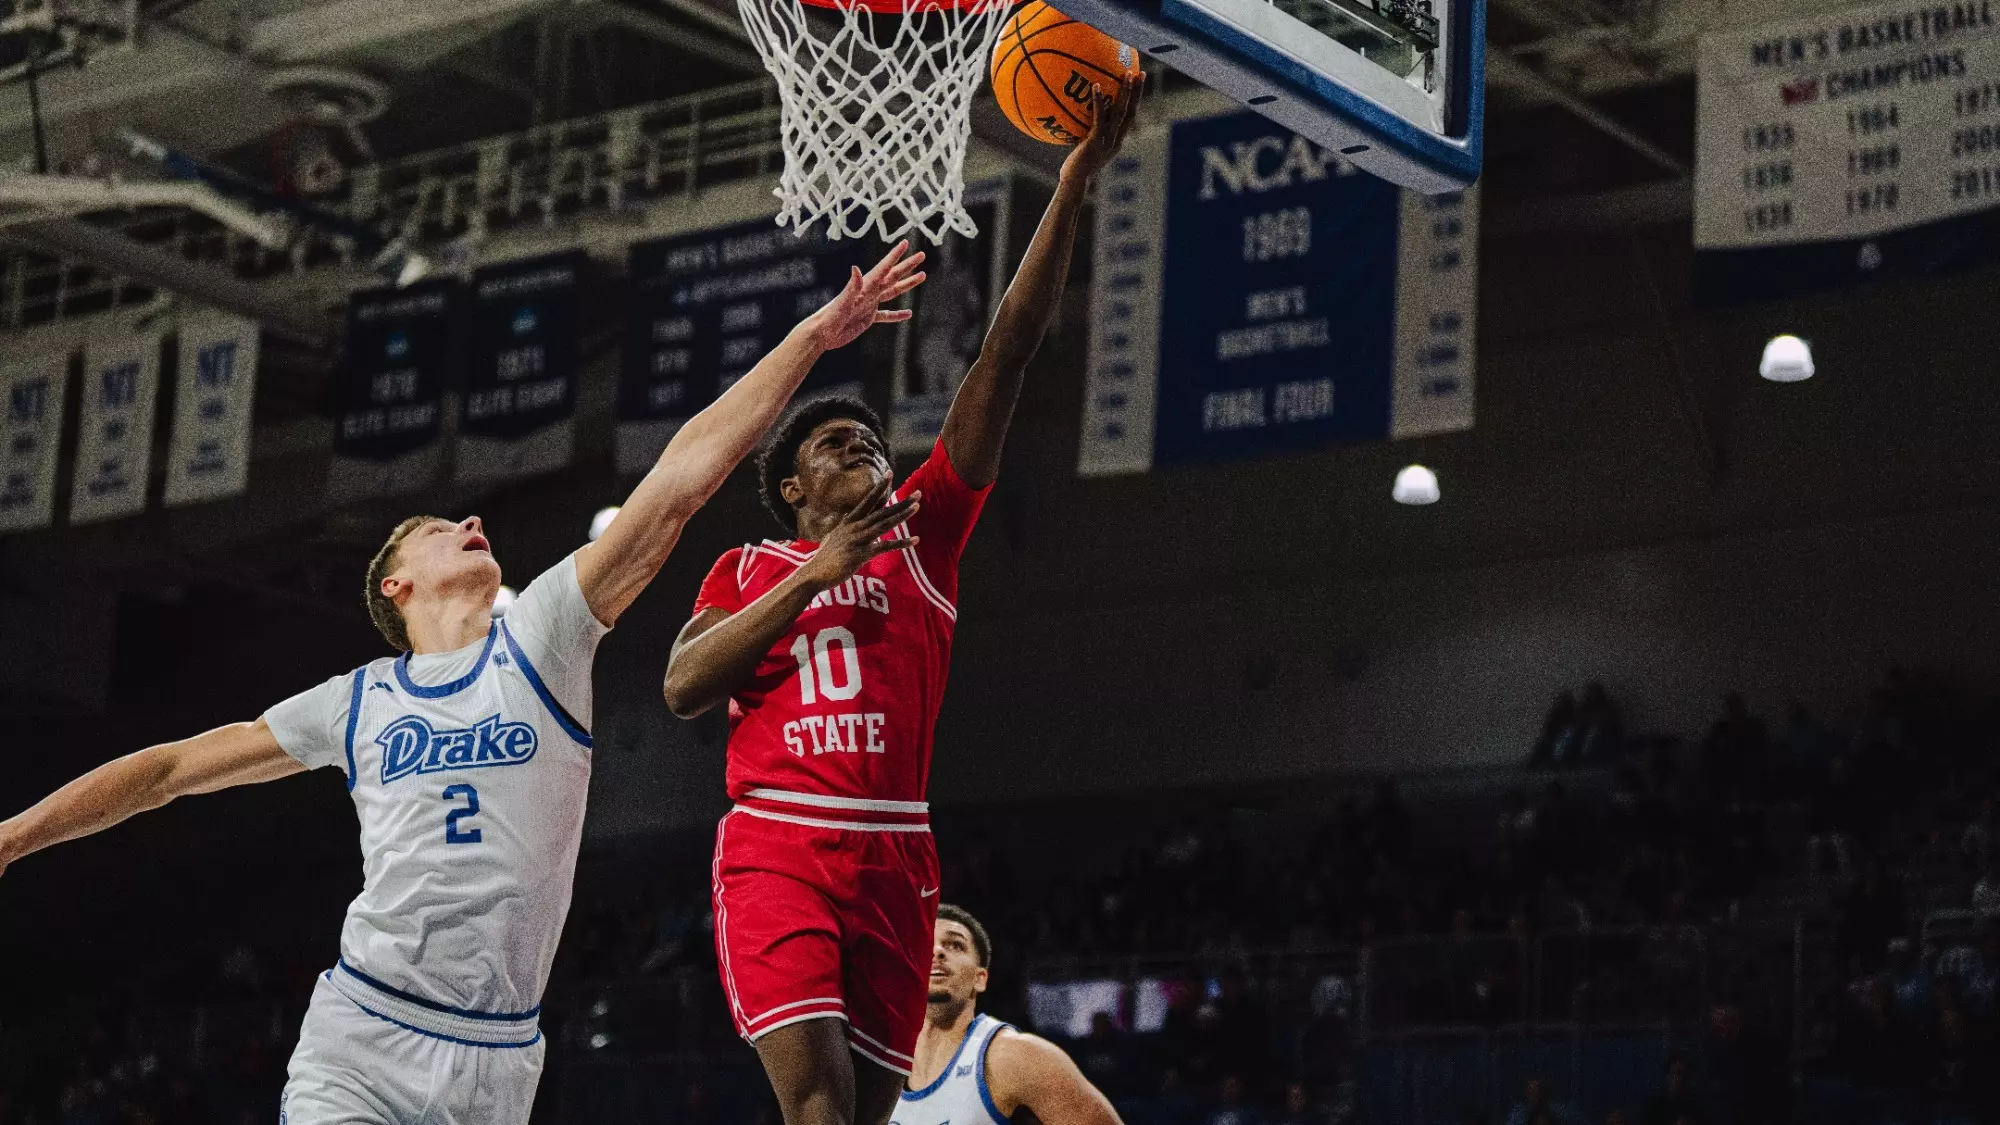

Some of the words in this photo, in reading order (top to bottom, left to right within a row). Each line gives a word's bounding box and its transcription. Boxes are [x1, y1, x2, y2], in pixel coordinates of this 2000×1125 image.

[1752, 33, 1828, 66] MEN'S
[1838, 1, 1993, 53] BASKETBALL
[1826, 51, 1966, 98] CHAMPIONS
[1216, 316, 1332, 361] BASKETBALL
[1202, 384, 1268, 432] FINAL
[1274, 377, 1336, 423] FOUR
[790, 625, 862, 705] 10
[374, 713, 538, 785] Drake
[783, 713, 885, 758] STATE
[442, 783, 482, 844] 2
